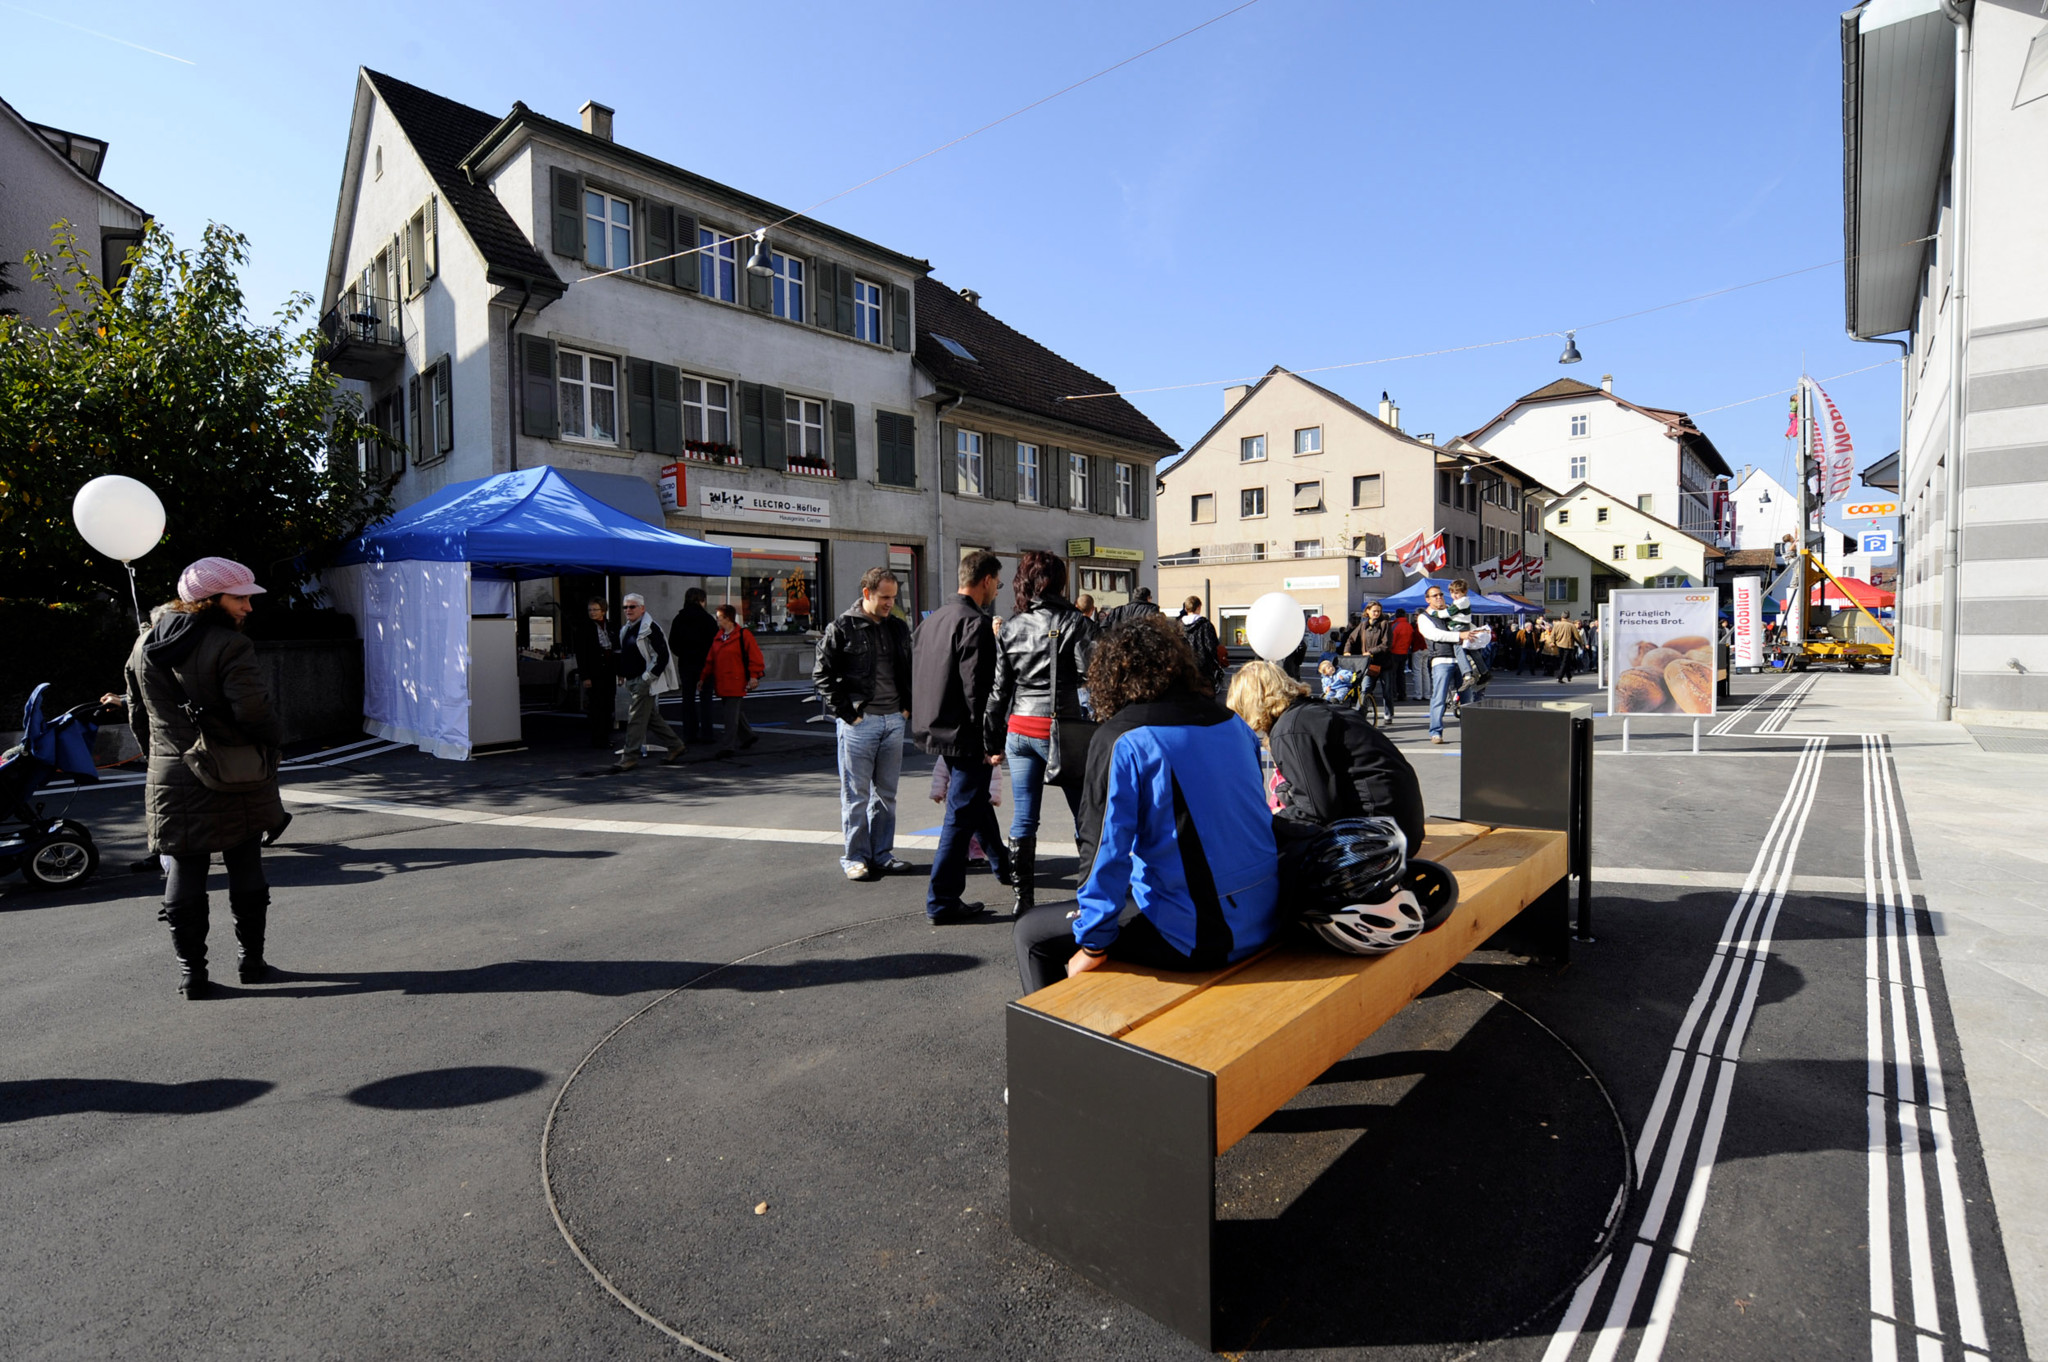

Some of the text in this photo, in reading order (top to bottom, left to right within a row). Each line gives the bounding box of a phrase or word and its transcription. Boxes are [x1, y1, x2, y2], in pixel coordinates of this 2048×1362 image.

[1847, 503, 1896, 515] coop
[806, 516, 822, 524] Center
[1870, 540, 1881, 550] P
[1637, 610, 1671, 618] täglich
[1736, 587, 1752, 660] Die Mobiliar
